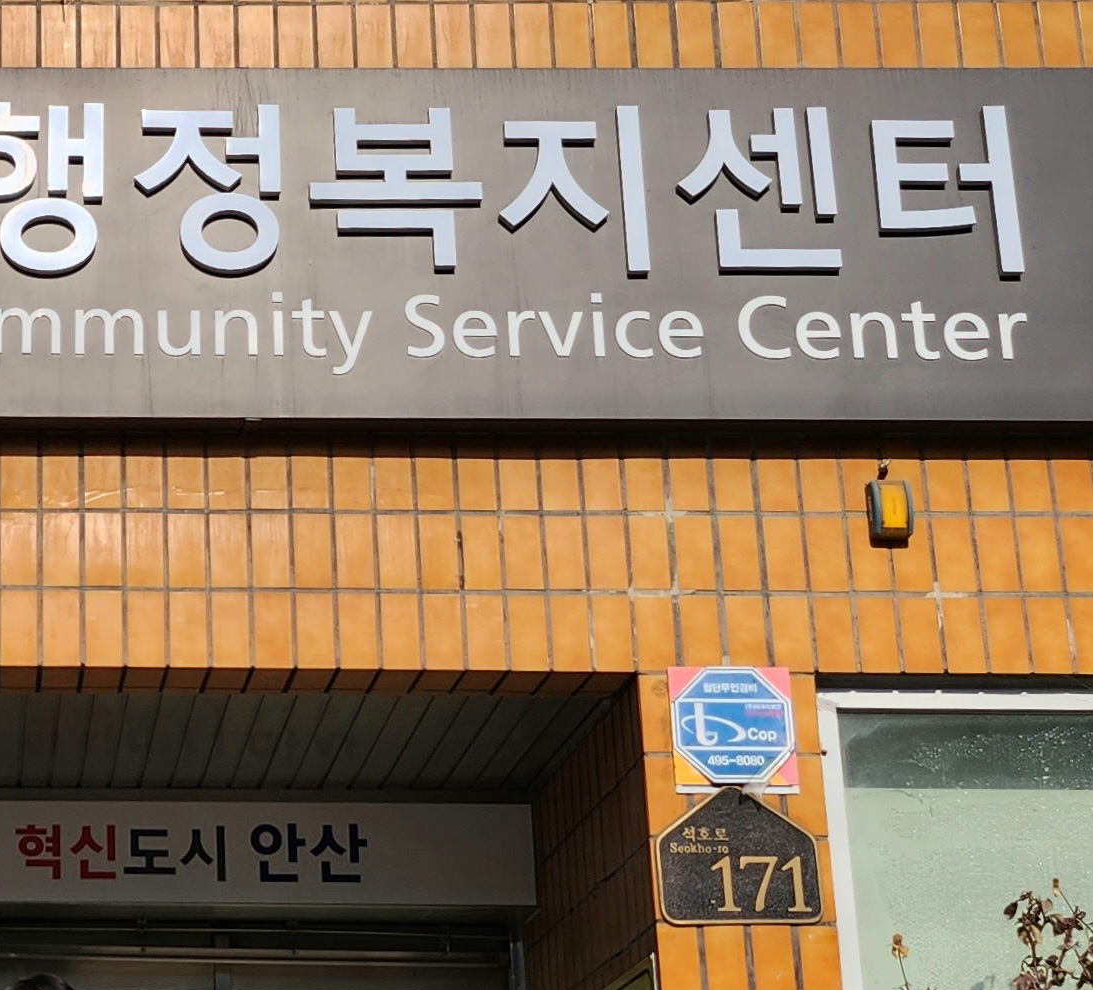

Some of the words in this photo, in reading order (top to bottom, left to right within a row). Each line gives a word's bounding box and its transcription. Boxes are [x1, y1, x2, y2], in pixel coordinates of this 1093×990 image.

[407, 293, 704, 361] Service
[737, 296, 1028, 362] Center
[708, 755, 765, 767] 495-8080
[669, 842, 729, 855] Seokho-ro
[681, 826, 729, 842] 석호로
[15, 823, 227, 882] 혁신도시
[250, 823, 368, 883] 안산
[711, 855, 812, 912] 171
